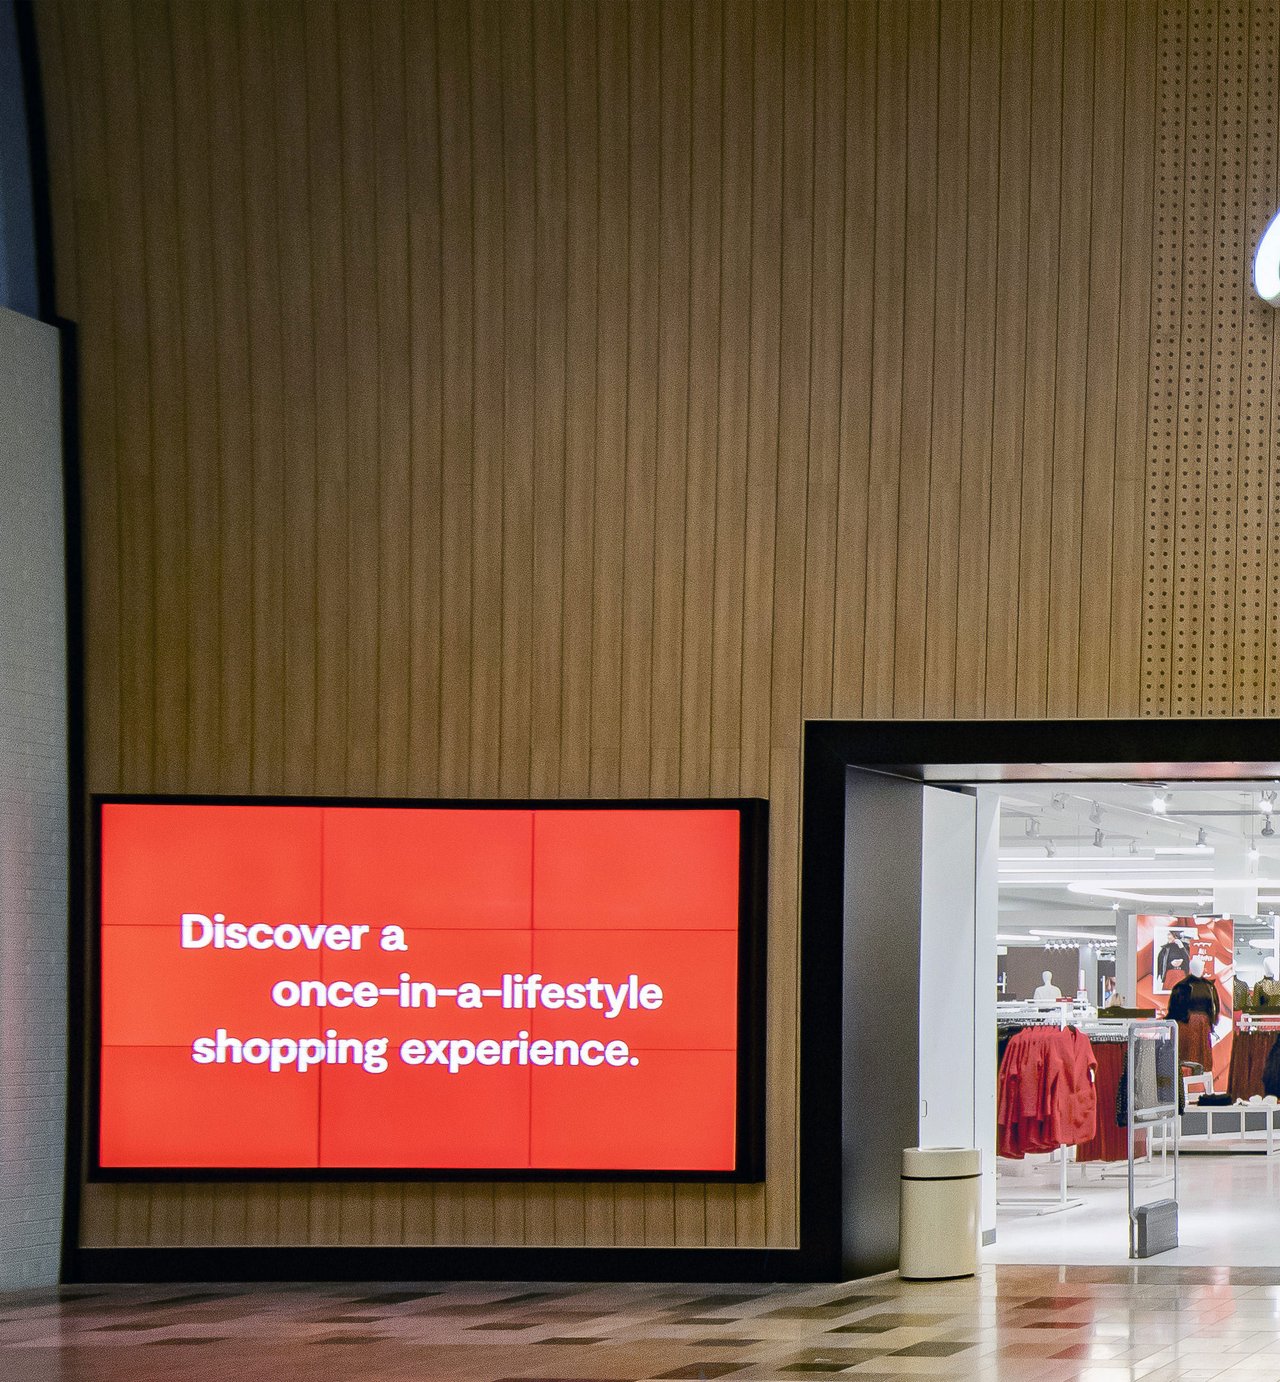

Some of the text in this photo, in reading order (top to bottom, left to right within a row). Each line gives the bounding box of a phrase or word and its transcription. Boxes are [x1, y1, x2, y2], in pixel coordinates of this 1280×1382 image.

[181, 913, 408, 952] Discover a
[272, 972, 664, 1019] once-in-a-lifestyle
[191, 1028, 640, 1075] shopping experience.
